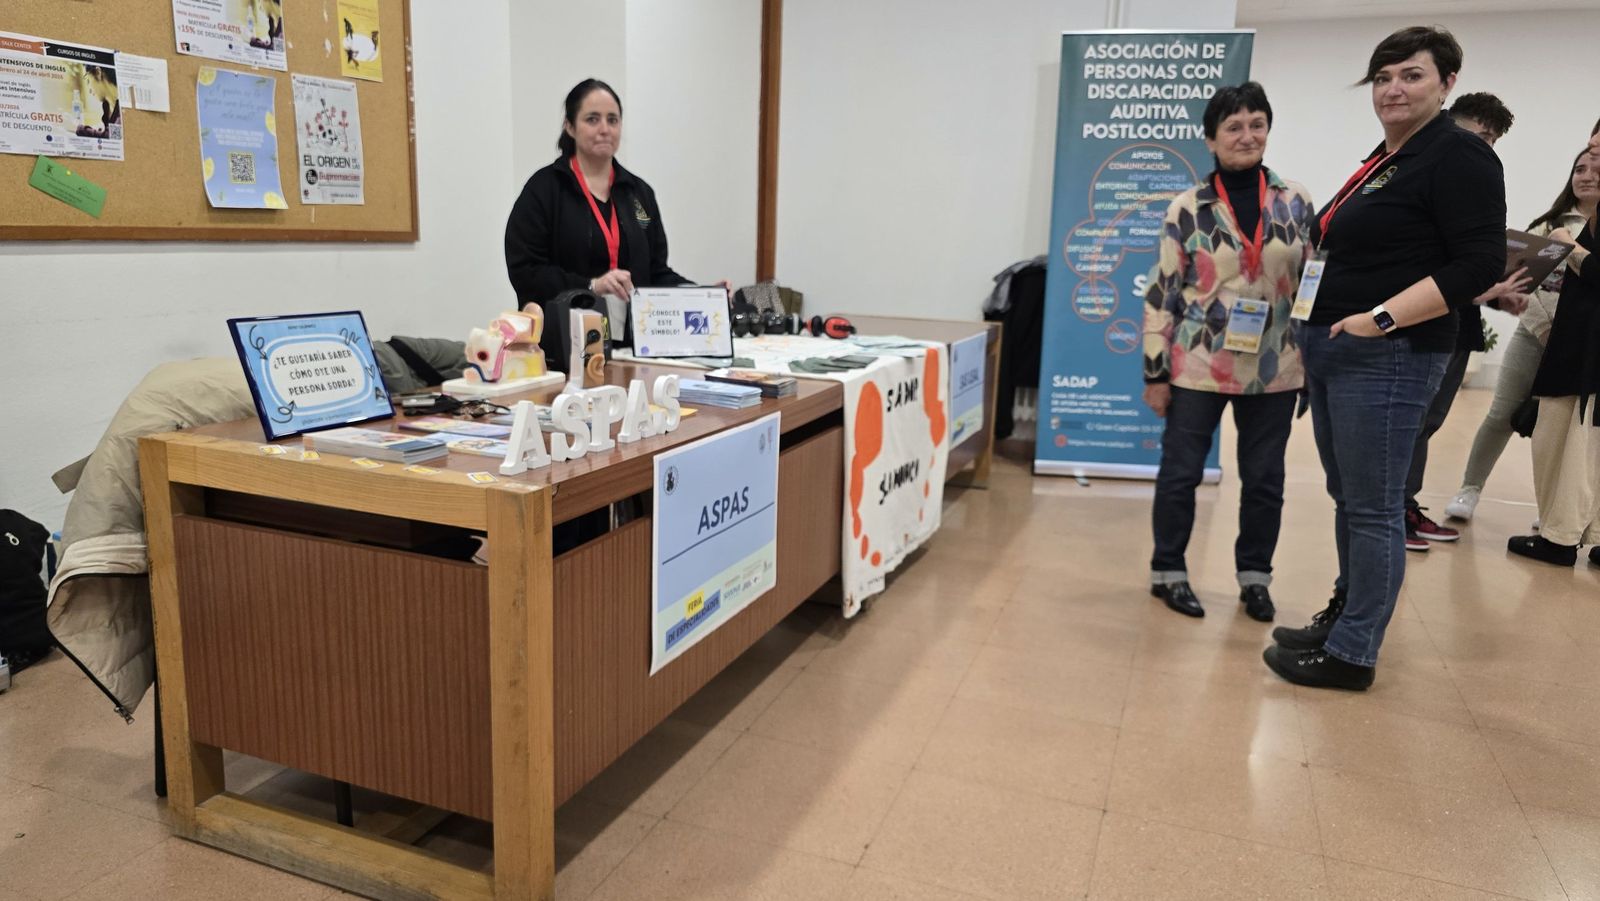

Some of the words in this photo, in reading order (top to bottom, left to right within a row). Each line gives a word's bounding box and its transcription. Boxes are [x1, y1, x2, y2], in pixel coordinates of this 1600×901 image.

[217, 22, 241, 34] GRATIS
[205, 31, 233, 41] DESCUENTO
[1084, 41, 1198, 59] ASOCIACIÓN
[1202, 44, 1226, 59] DE
[1083, 64, 1178, 79] PERSONAS
[1182, 64, 1223, 79] CON
[1087, 84, 1216, 99] DISCAPACIDAD
[30, 111, 64, 123] GRATIS
[1110, 104, 1189, 120] AUDITIVA
[13, 122, 52, 132] DESCUENTO
[303, 154, 316, 166] EL
[317, 154, 350, 168] ORIGEN
[1131, 151, 1164, 160] APOYOS
[649, 310, 680, 318] ¿CONOCES
[273, 355, 287, 370] ¿TE
[288, 350, 327, 365] GUSTARÍA
[328, 349, 353, 361] SABER
[290, 368, 313, 380] CÓMO
[314, 367, 330, 377] OYE
[331, 365, 346, 375] UNA
[288, 382, 326, 396] PERSONA
[327, 379, 356, 391] SORDA?
[1052, 374, 1099, 389] SADAP
[500, 374, 681, 476] ASPAS
[697, 486, 750, 535] ASPAS
